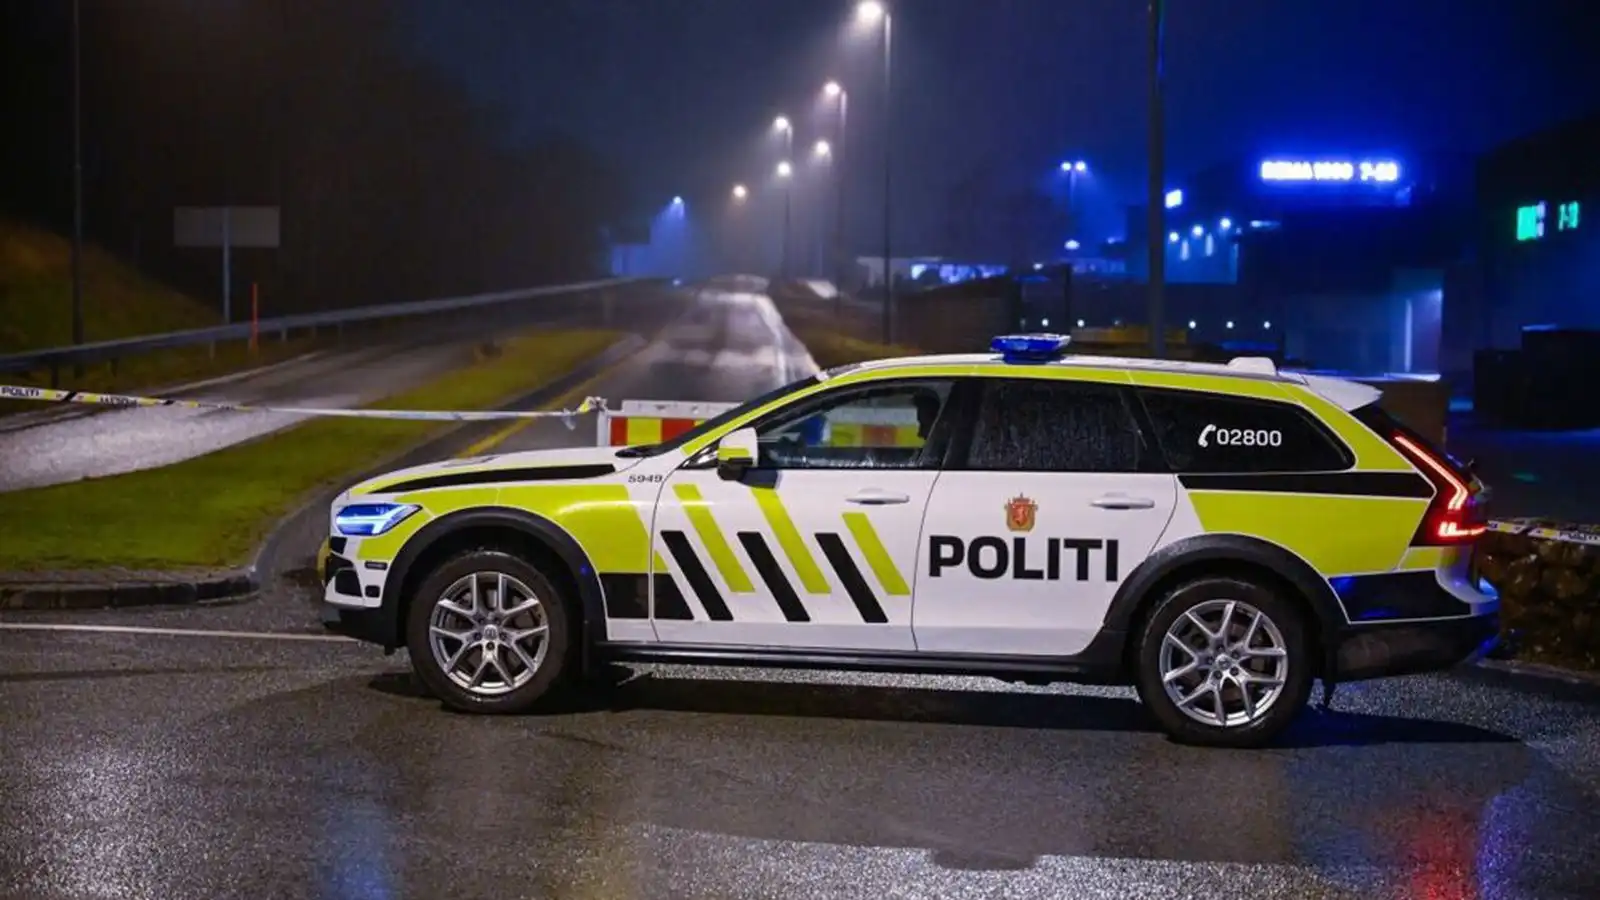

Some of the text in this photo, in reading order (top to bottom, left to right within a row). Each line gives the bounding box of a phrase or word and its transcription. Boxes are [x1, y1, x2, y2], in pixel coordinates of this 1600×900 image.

[1216, 428, 1282, 447] 02800
[628, 474, 663, 483] 5949
[929, 535, 1119, 582] POLITI
